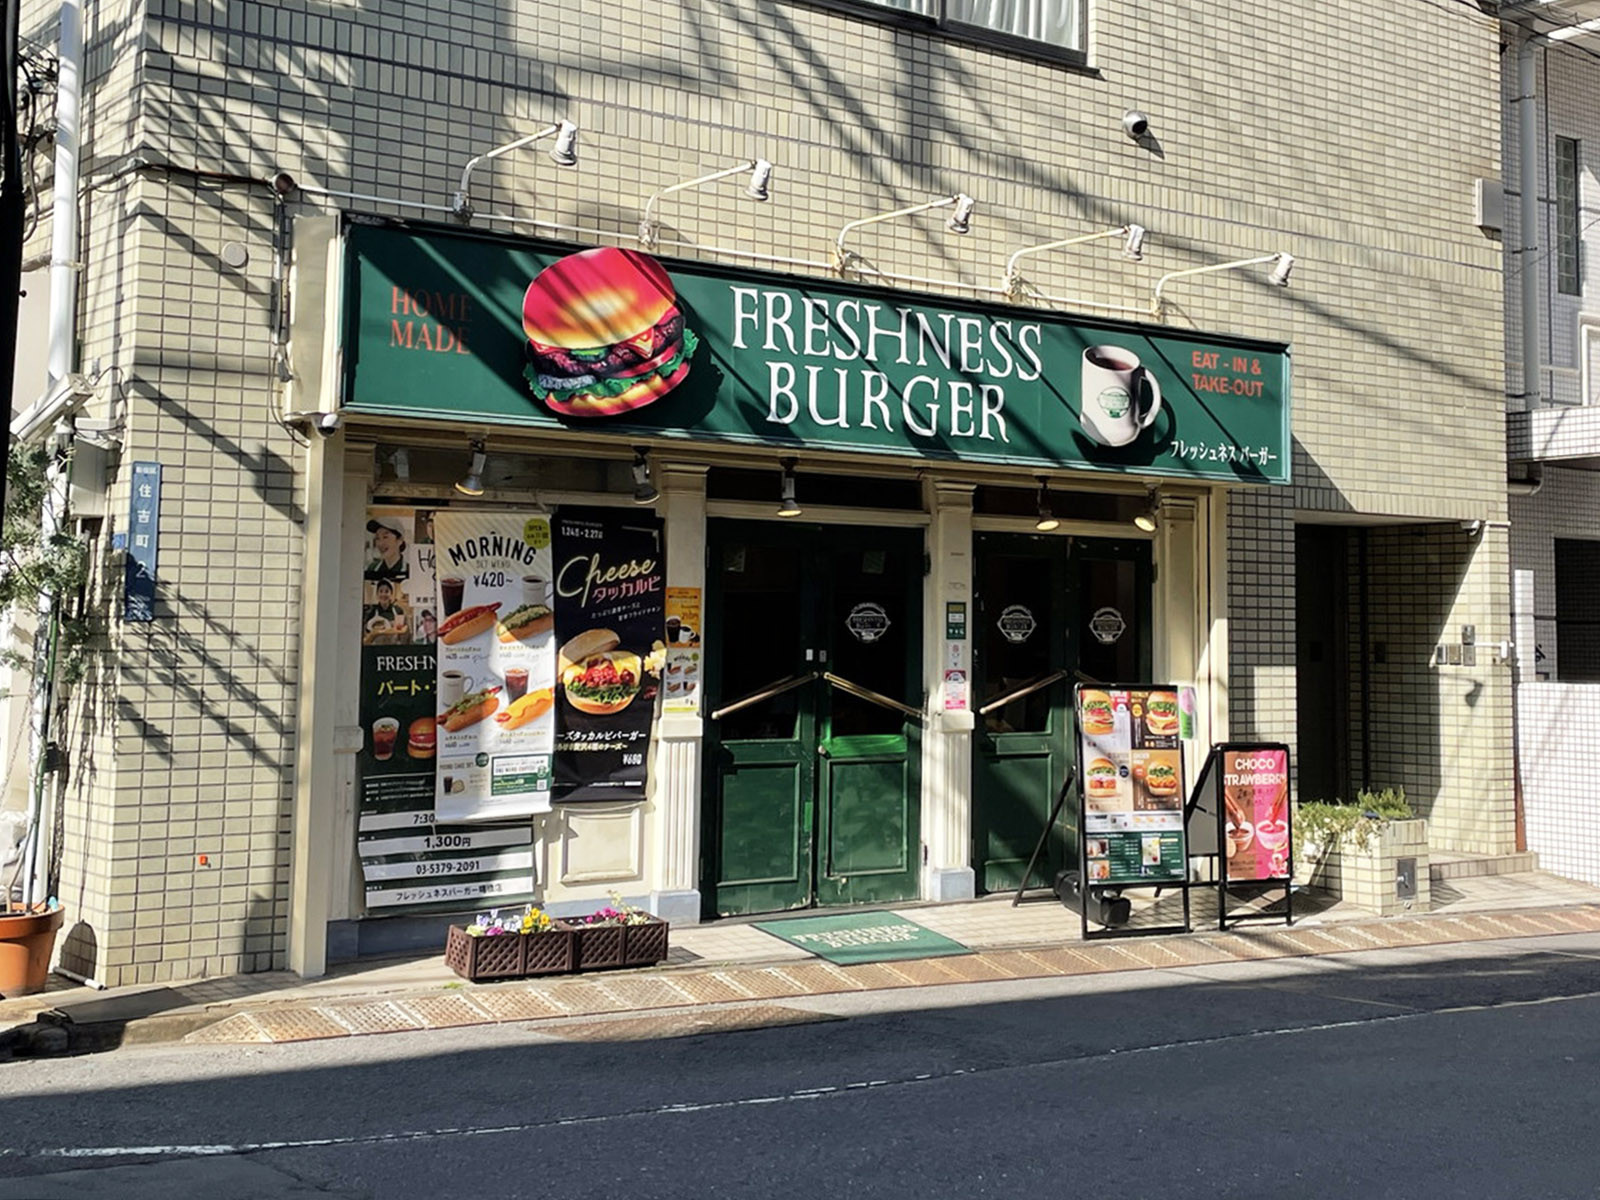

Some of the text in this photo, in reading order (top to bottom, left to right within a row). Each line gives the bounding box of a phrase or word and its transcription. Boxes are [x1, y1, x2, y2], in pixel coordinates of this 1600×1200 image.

[391, 285, 473, 321] HOME
[390, 319, 471, 355] MADE
[729, 286, 1042, 381] FRESHNESS
[1191, 351, 1219, 368] EAT
[1232, 356, 1247, 372] IN
[1250, 359, 1262, 375] &
[1191, 373, 1264, 397] TAKE-OUT
[765, 361, 1010, 443] BURGER
[1170, 440, 1278, 466] フレッシュネスバーガー
[448, 535, 537, 567] MORNING
[556, 552, 657, 608] Cheese
[592, 575, 661, 604] タッカルビ
[1234, 758, 1276, 770] CHOCO
[424, 835, 471, 849] 1,300円
[416, 860, 480, 875] 03-5379-2091
